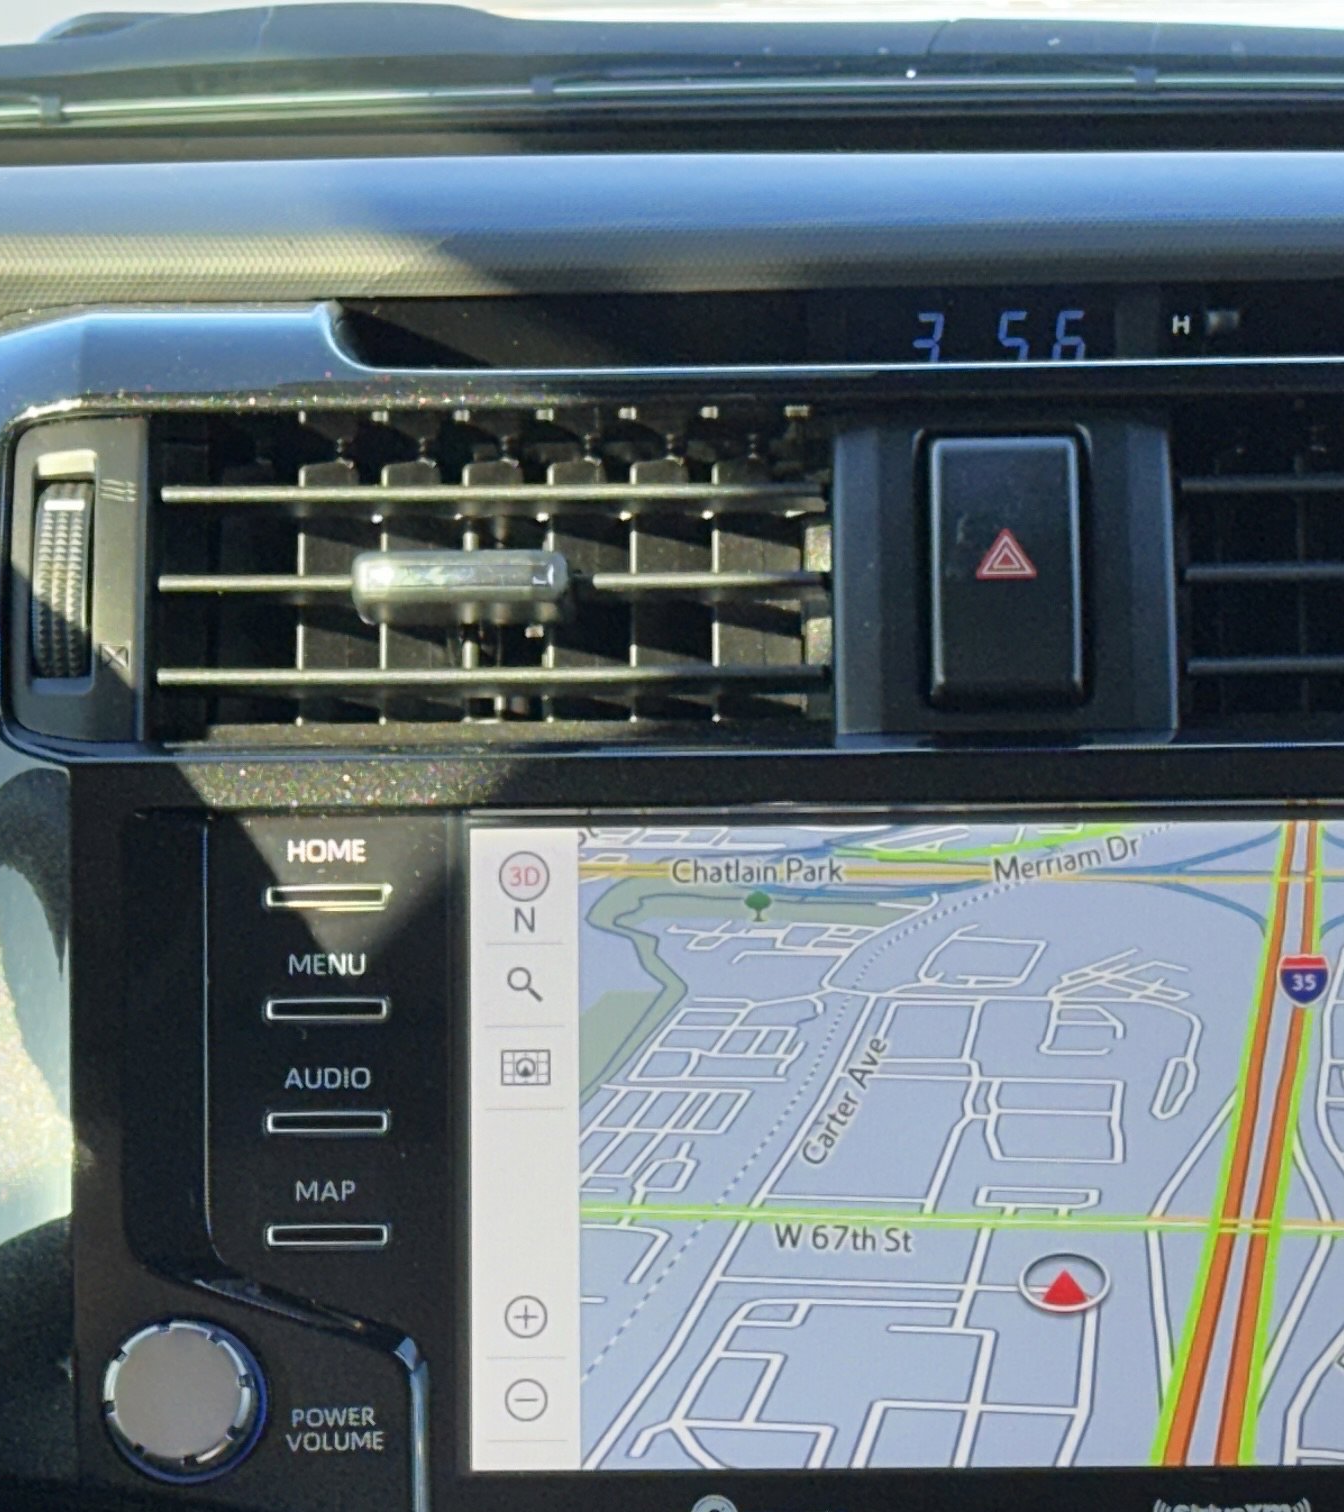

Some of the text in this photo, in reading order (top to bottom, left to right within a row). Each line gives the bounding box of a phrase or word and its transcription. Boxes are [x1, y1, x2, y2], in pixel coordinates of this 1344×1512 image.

[286, 838, 368, 864] HOME
[993, 835, 1141, 883] Merriam Dr
[508, 867, 541, 887] 3D
[670, 857, 844, 885] Chatlain Park
[513, 907, 536, 934] N
[288, 952, 367, 976] MENU
[1291, 973, 1317, 991] 35
[283, 1066, 372, 1090] AUDIO
[801, 1036, 888, 1167] Carter Ave
[294, 1179, 356, 1203] MAP
[774, 1223, 913, 1253] W 67th St
[291, 1406, 377, 1428] POWER
[284, 1430, 385, 1453] VOLUME
